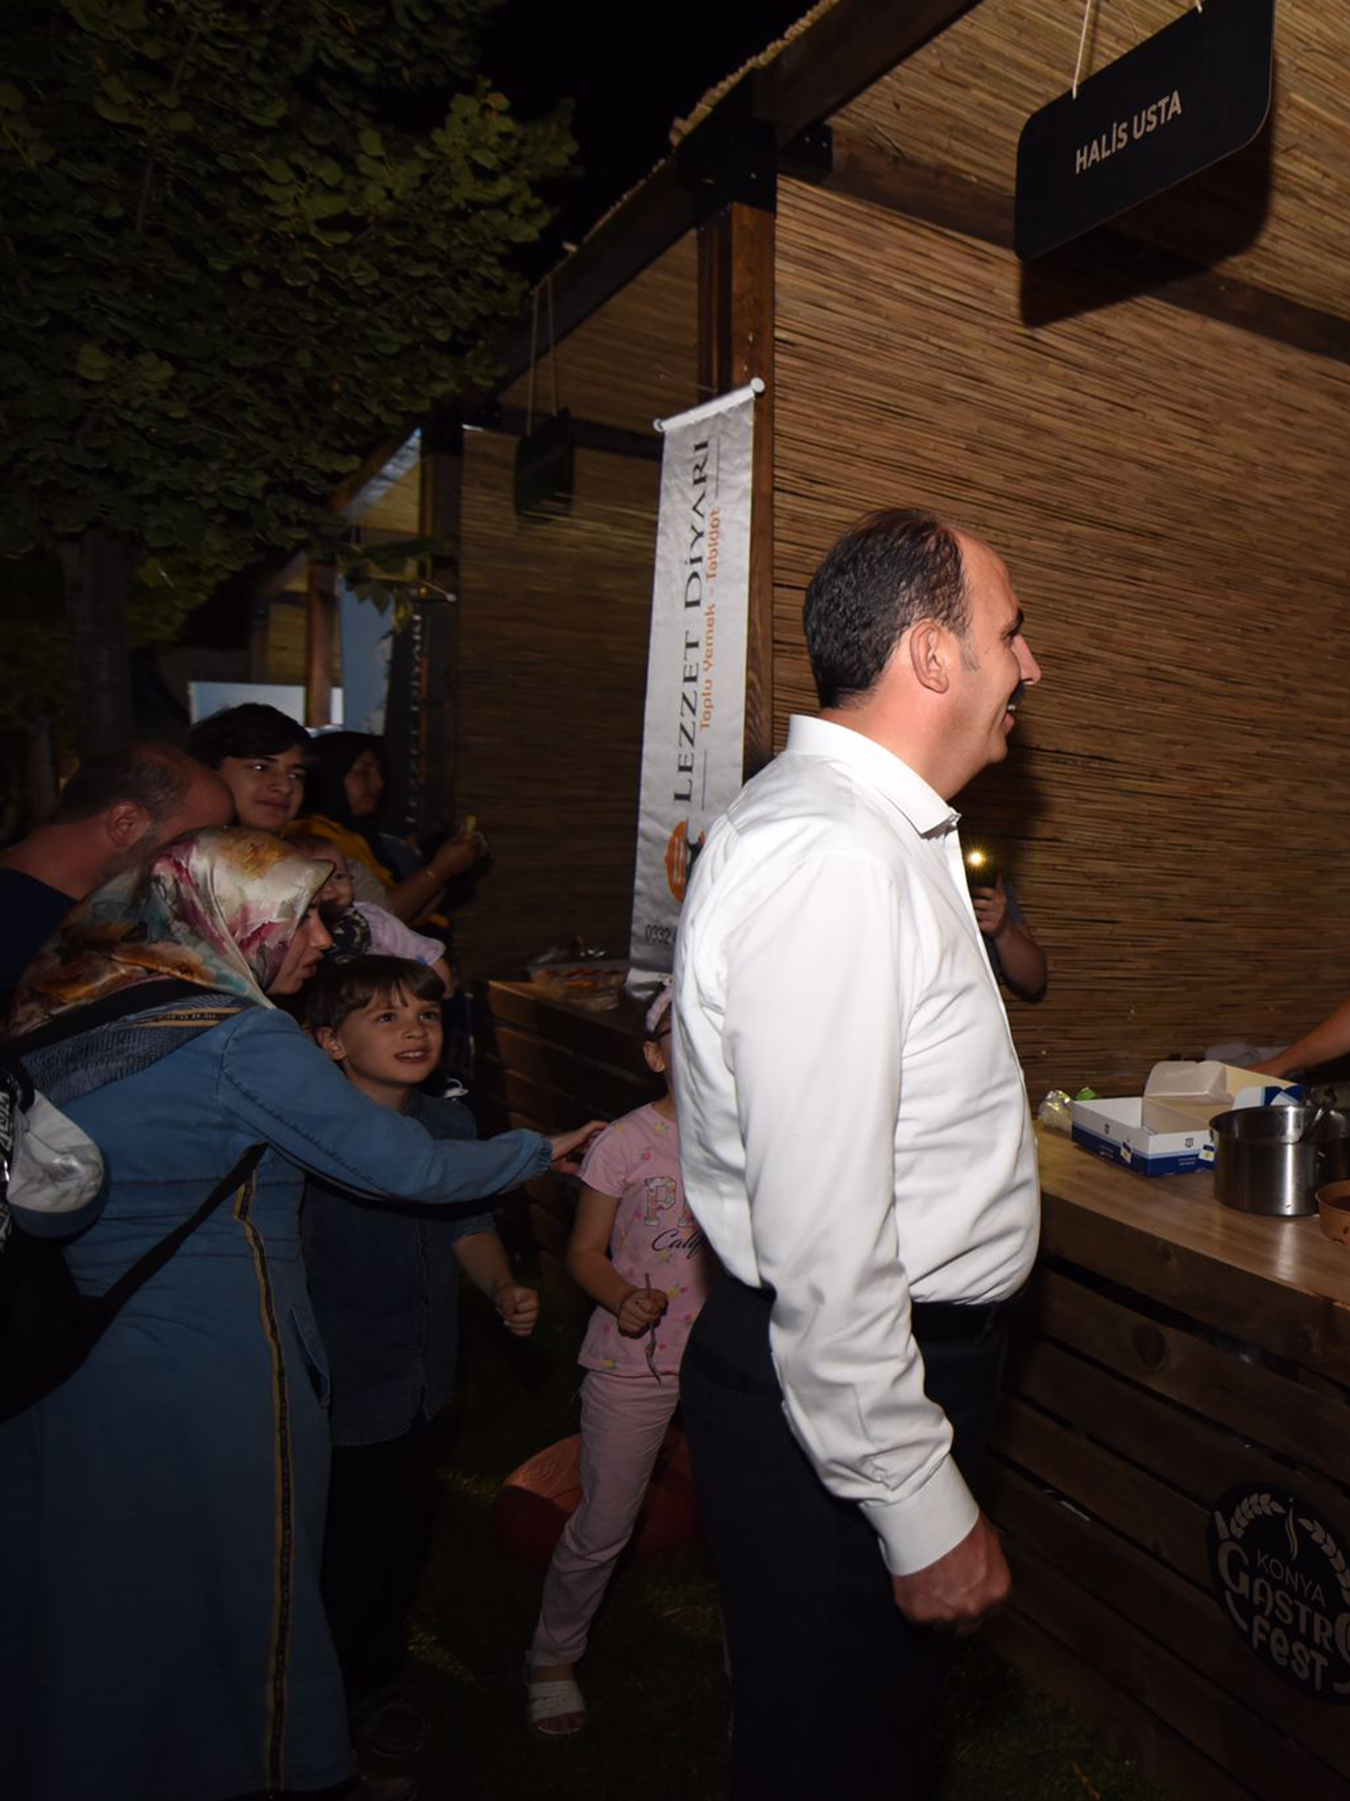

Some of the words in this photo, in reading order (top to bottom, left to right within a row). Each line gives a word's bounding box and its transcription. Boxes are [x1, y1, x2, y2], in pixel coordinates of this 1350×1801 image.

[1075, 121, 1128, 174] HALİS
[1132, 90, 1182, 140] USTA
[684, 440, 708, 609] DİYARI
[703, 603, 716, 672] Yemek
[674, 630, 700, 802] LEZZET
[700, 679, 714, 732] Toplu
[645, 924, 671, 944] 0332
[1256, 1550, 1326, 1608] KONYA
